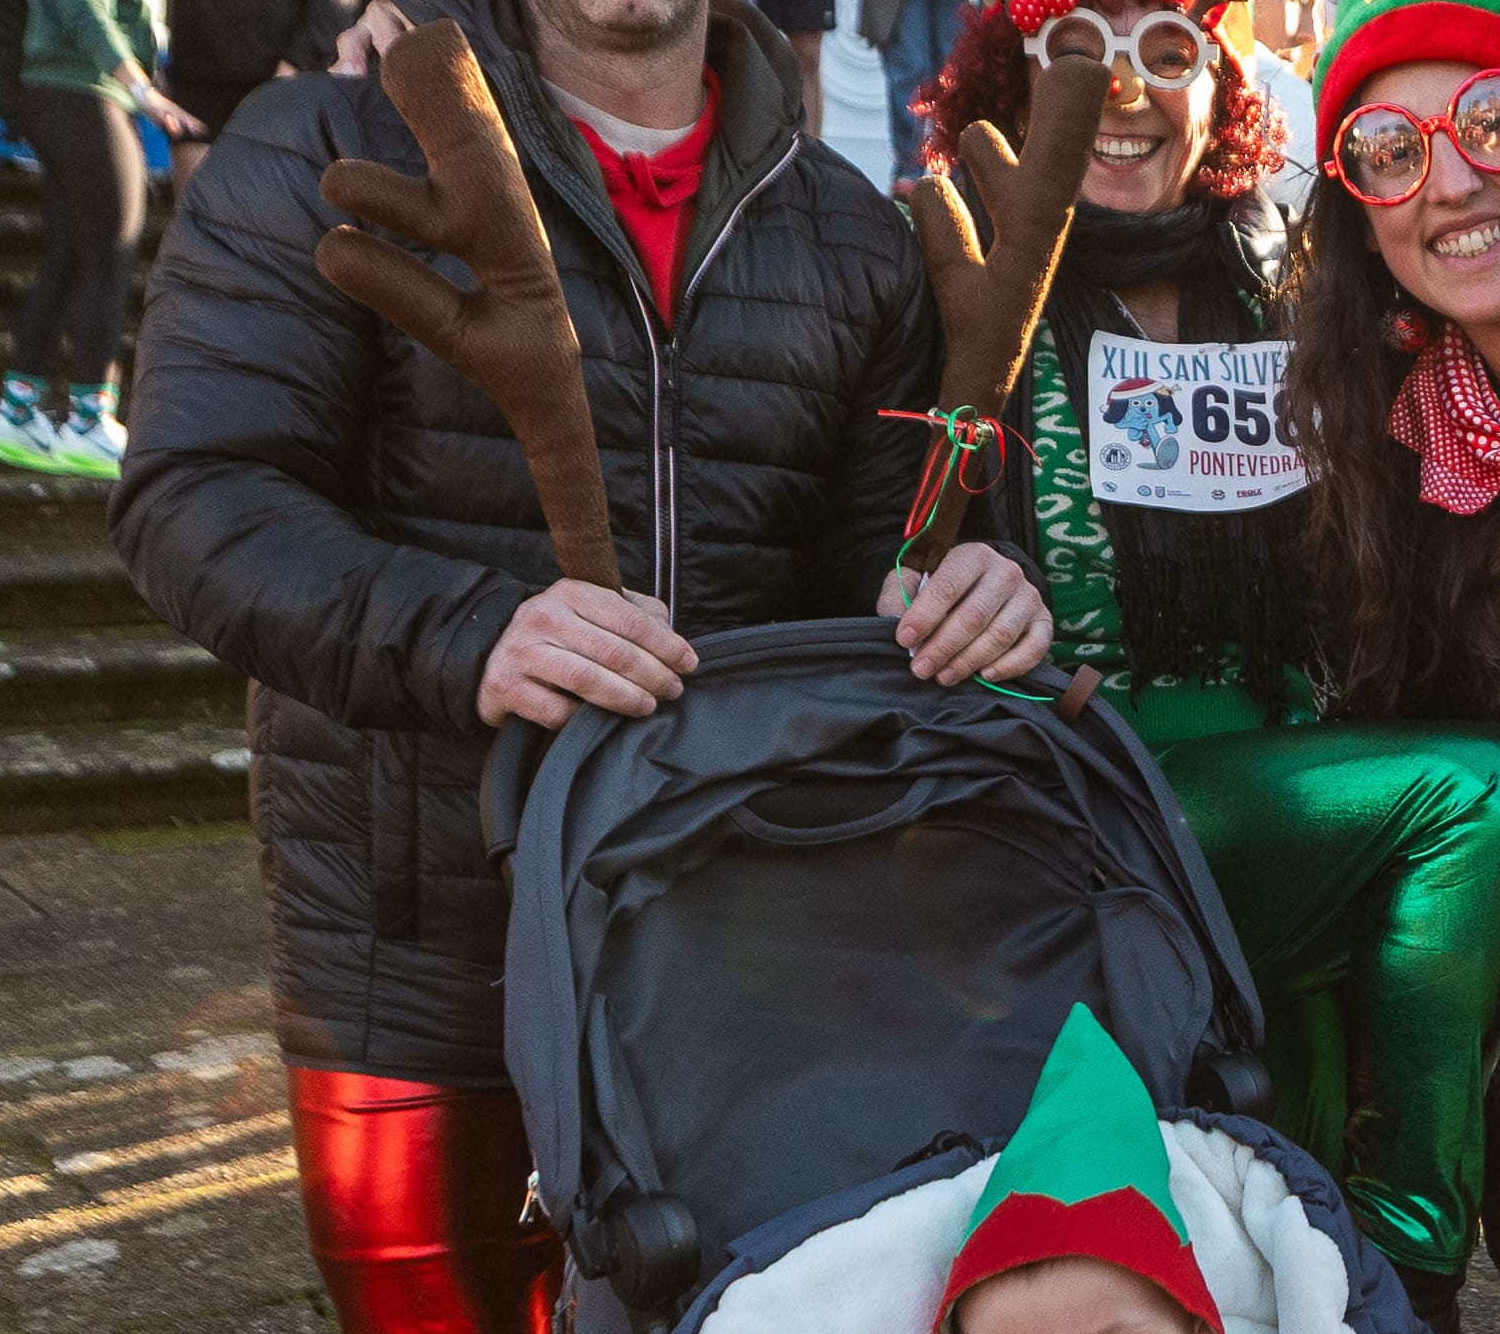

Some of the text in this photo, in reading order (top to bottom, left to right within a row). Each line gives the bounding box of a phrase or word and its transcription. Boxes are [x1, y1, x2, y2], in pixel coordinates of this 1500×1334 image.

[1158, 352, 1211, 382] SAN
[1219, 350, 1288, 386] SILVE
[1190, 450, 1306, 477] PONTEVEDRA
